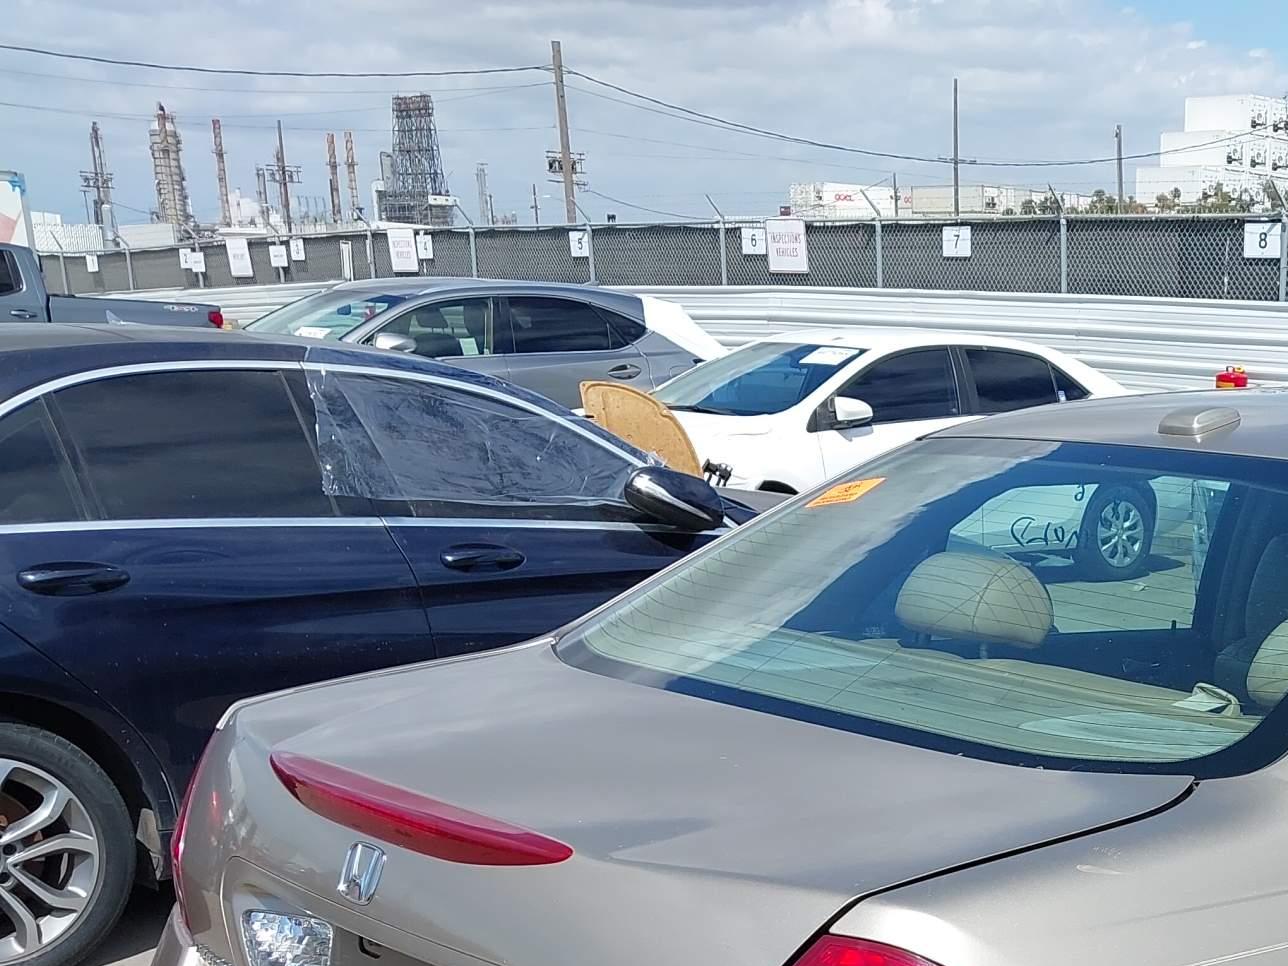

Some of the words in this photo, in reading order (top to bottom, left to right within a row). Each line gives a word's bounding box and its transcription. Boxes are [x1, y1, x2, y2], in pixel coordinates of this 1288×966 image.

[577, 237, 583, 250] 5
[750, 234, 757, 247] 6
[953, 234, 960, 249] 7
[1258, 231, 1268, 249] 8
